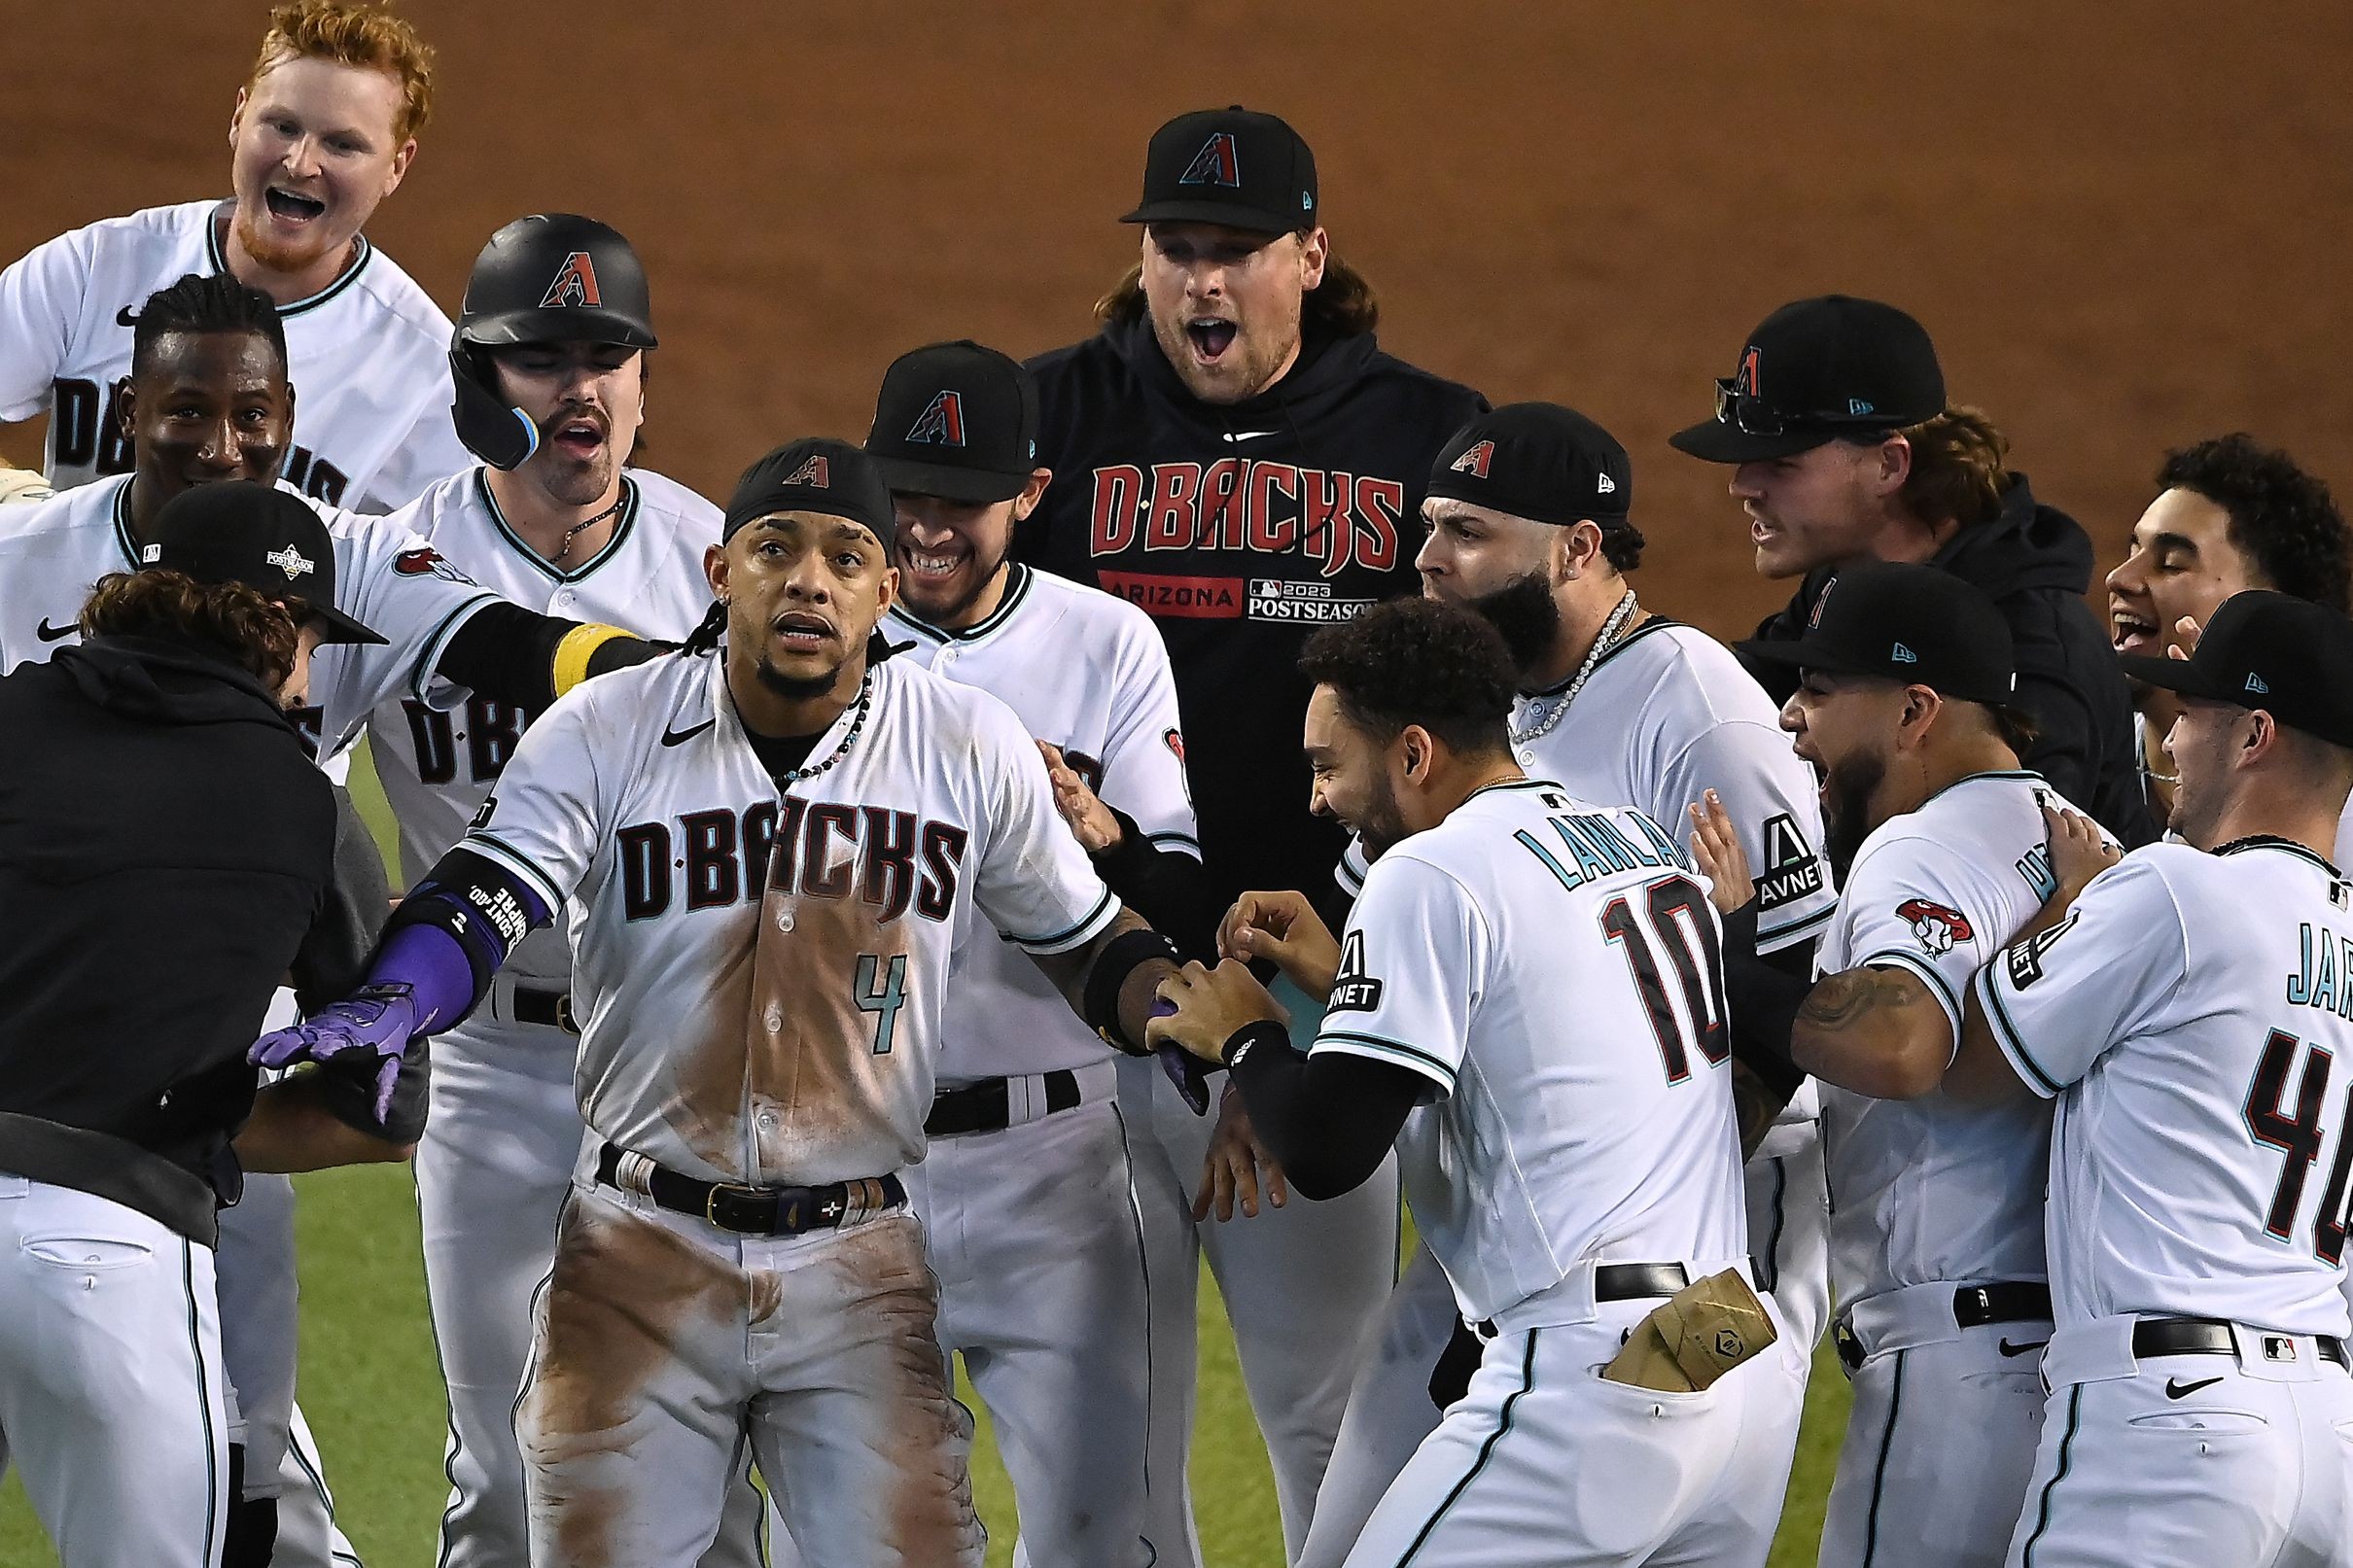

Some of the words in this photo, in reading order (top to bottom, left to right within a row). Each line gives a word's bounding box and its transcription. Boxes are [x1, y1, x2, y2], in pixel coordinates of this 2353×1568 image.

[538, 251, 602, 308] A
[1110, 582, 1234, 607] ARIZONA
[1282, 585, 1331, 597] 2023
[1761, 861, 1823, 905] AVNET
[1596, 871, 1732, 1088] 10
[853, 954, 908, 1056] 4
